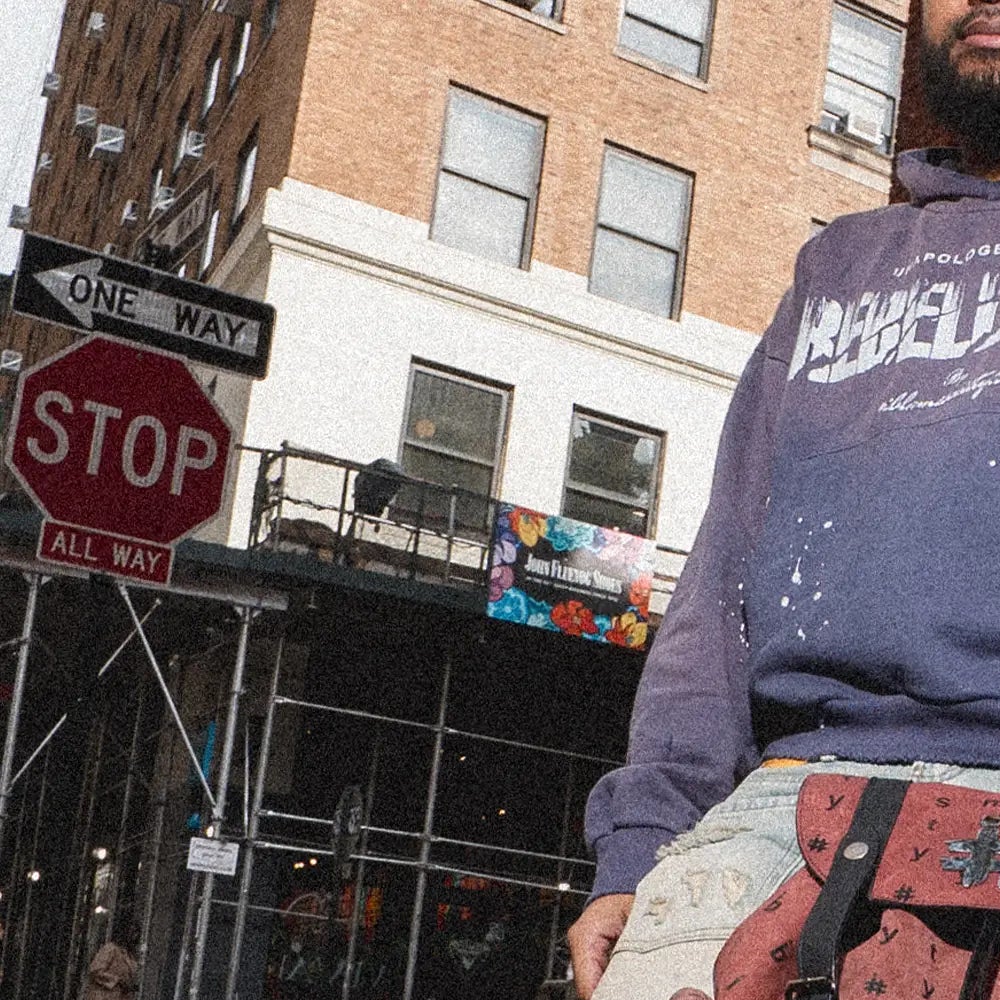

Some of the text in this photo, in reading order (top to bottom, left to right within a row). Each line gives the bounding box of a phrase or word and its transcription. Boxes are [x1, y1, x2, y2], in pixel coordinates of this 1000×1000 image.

[68, 274, 248, 347] ONE WAY
[26, 390, 218, 497] STOP
[50, 531, 163, 574] ALL WAY
